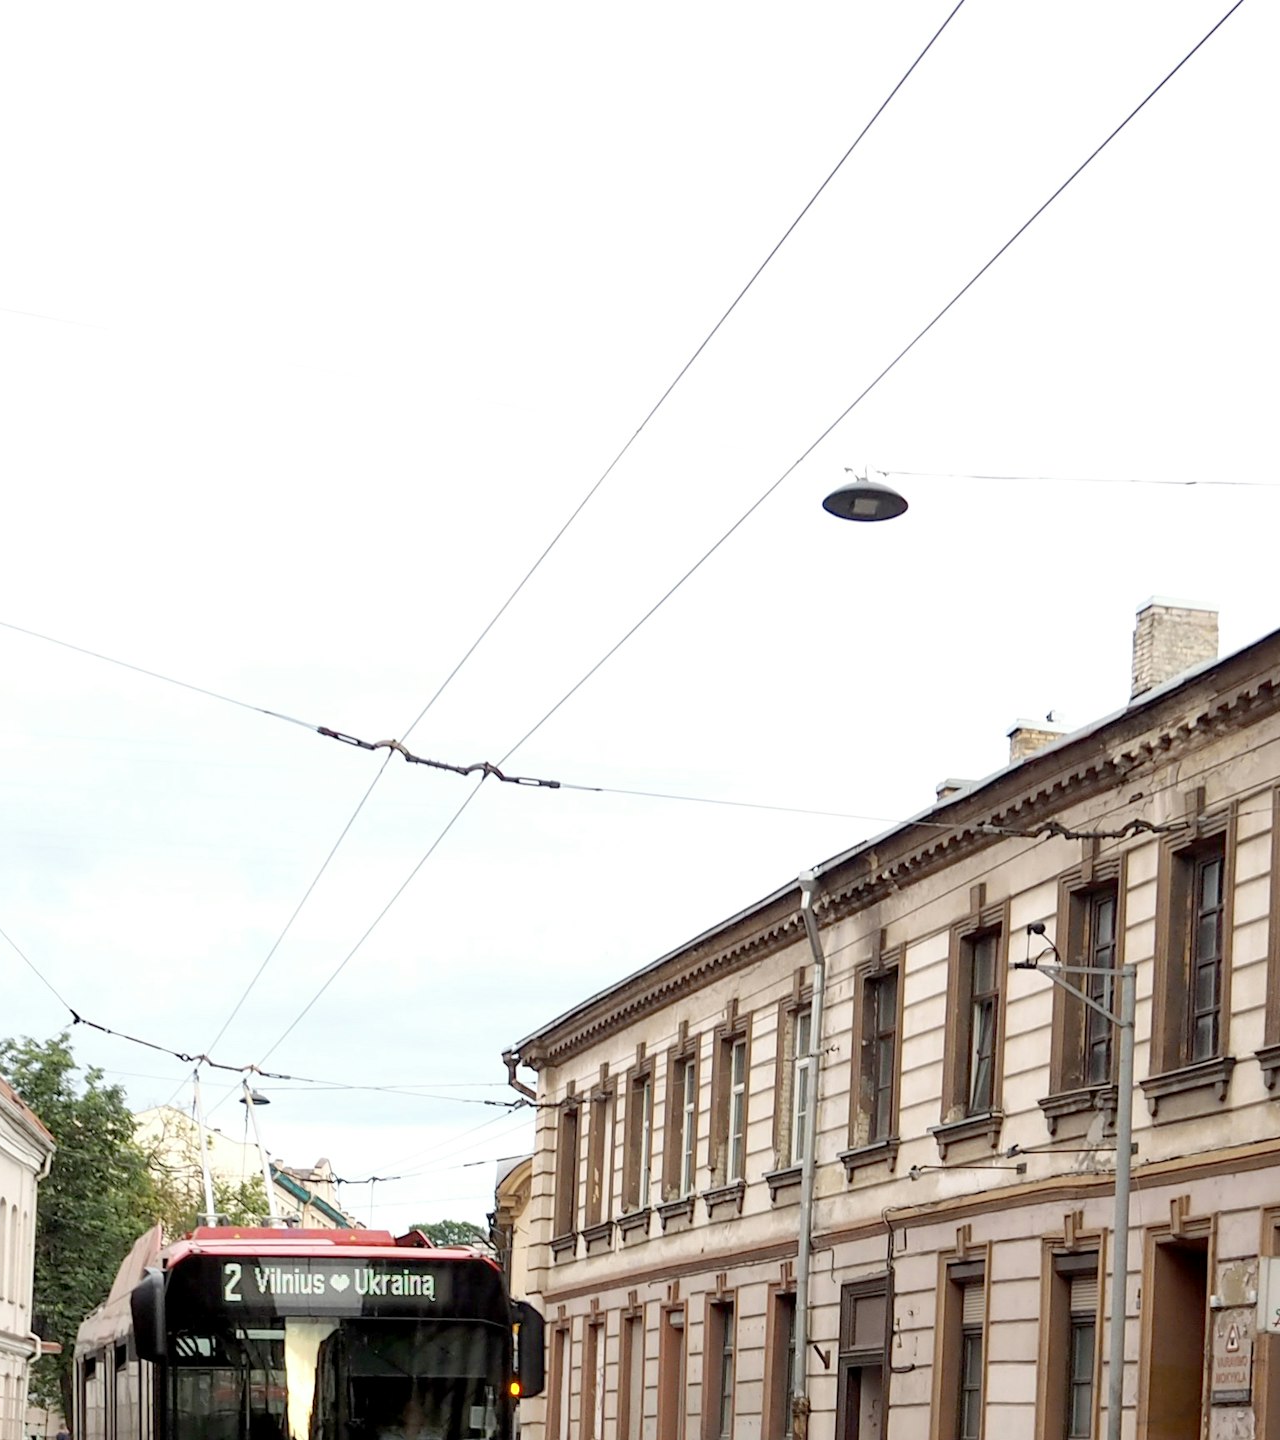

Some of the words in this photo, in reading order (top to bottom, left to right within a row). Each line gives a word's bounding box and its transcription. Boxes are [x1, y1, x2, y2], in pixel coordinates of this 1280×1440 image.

[224, 1263, 242, 1301] 2
[254, 1268, 325, 1295] Vilnius
[354, 1268, 436, 1301] Ukrainą
